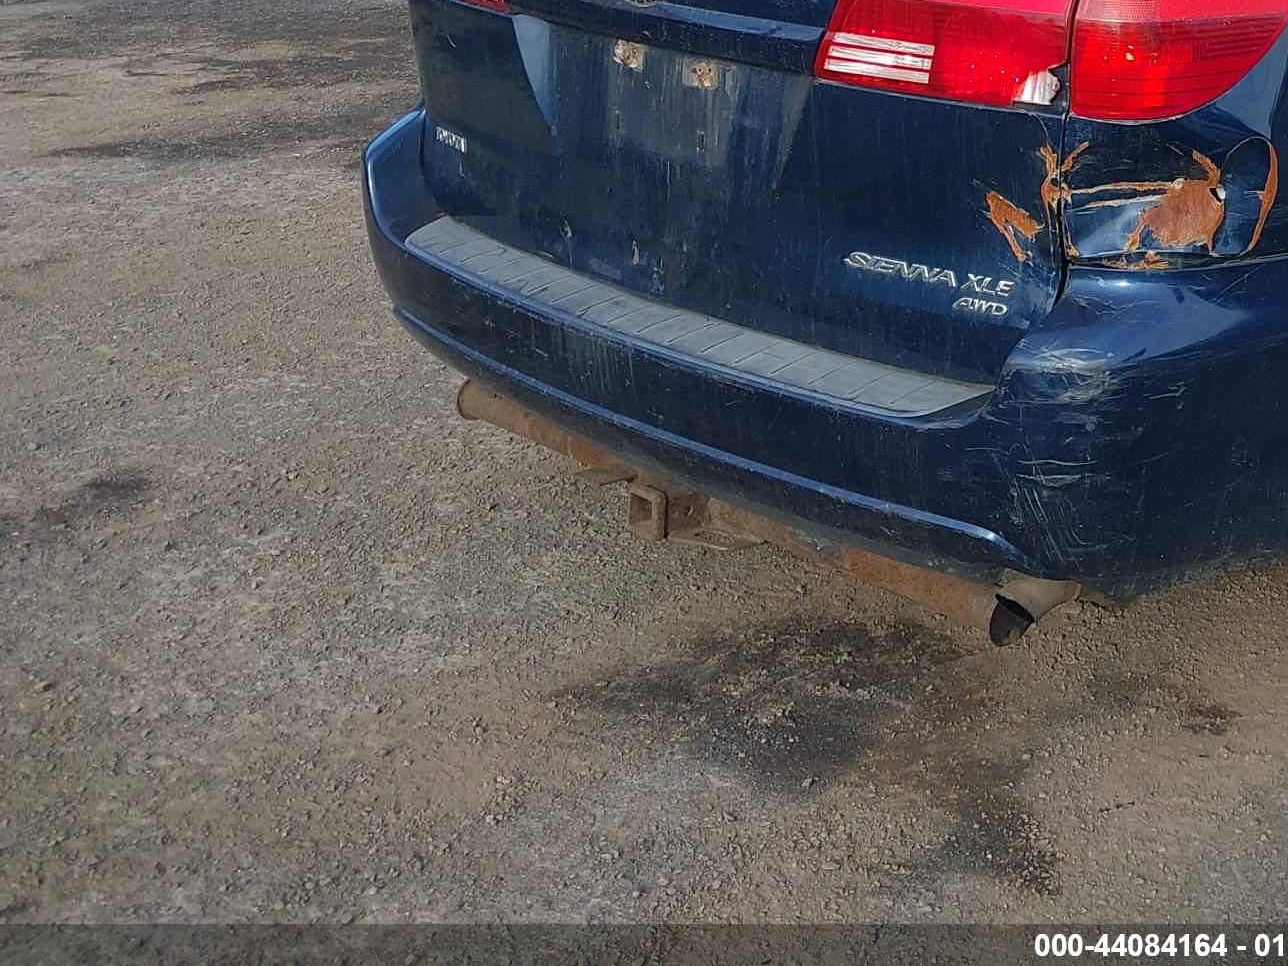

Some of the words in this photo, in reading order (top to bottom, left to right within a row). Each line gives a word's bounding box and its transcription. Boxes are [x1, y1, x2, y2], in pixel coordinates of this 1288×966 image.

[843, 251, 957, 288] SIENNA
[960, 273, 1015, 297] XLE
[952, 297, 1008, 317] AWD
